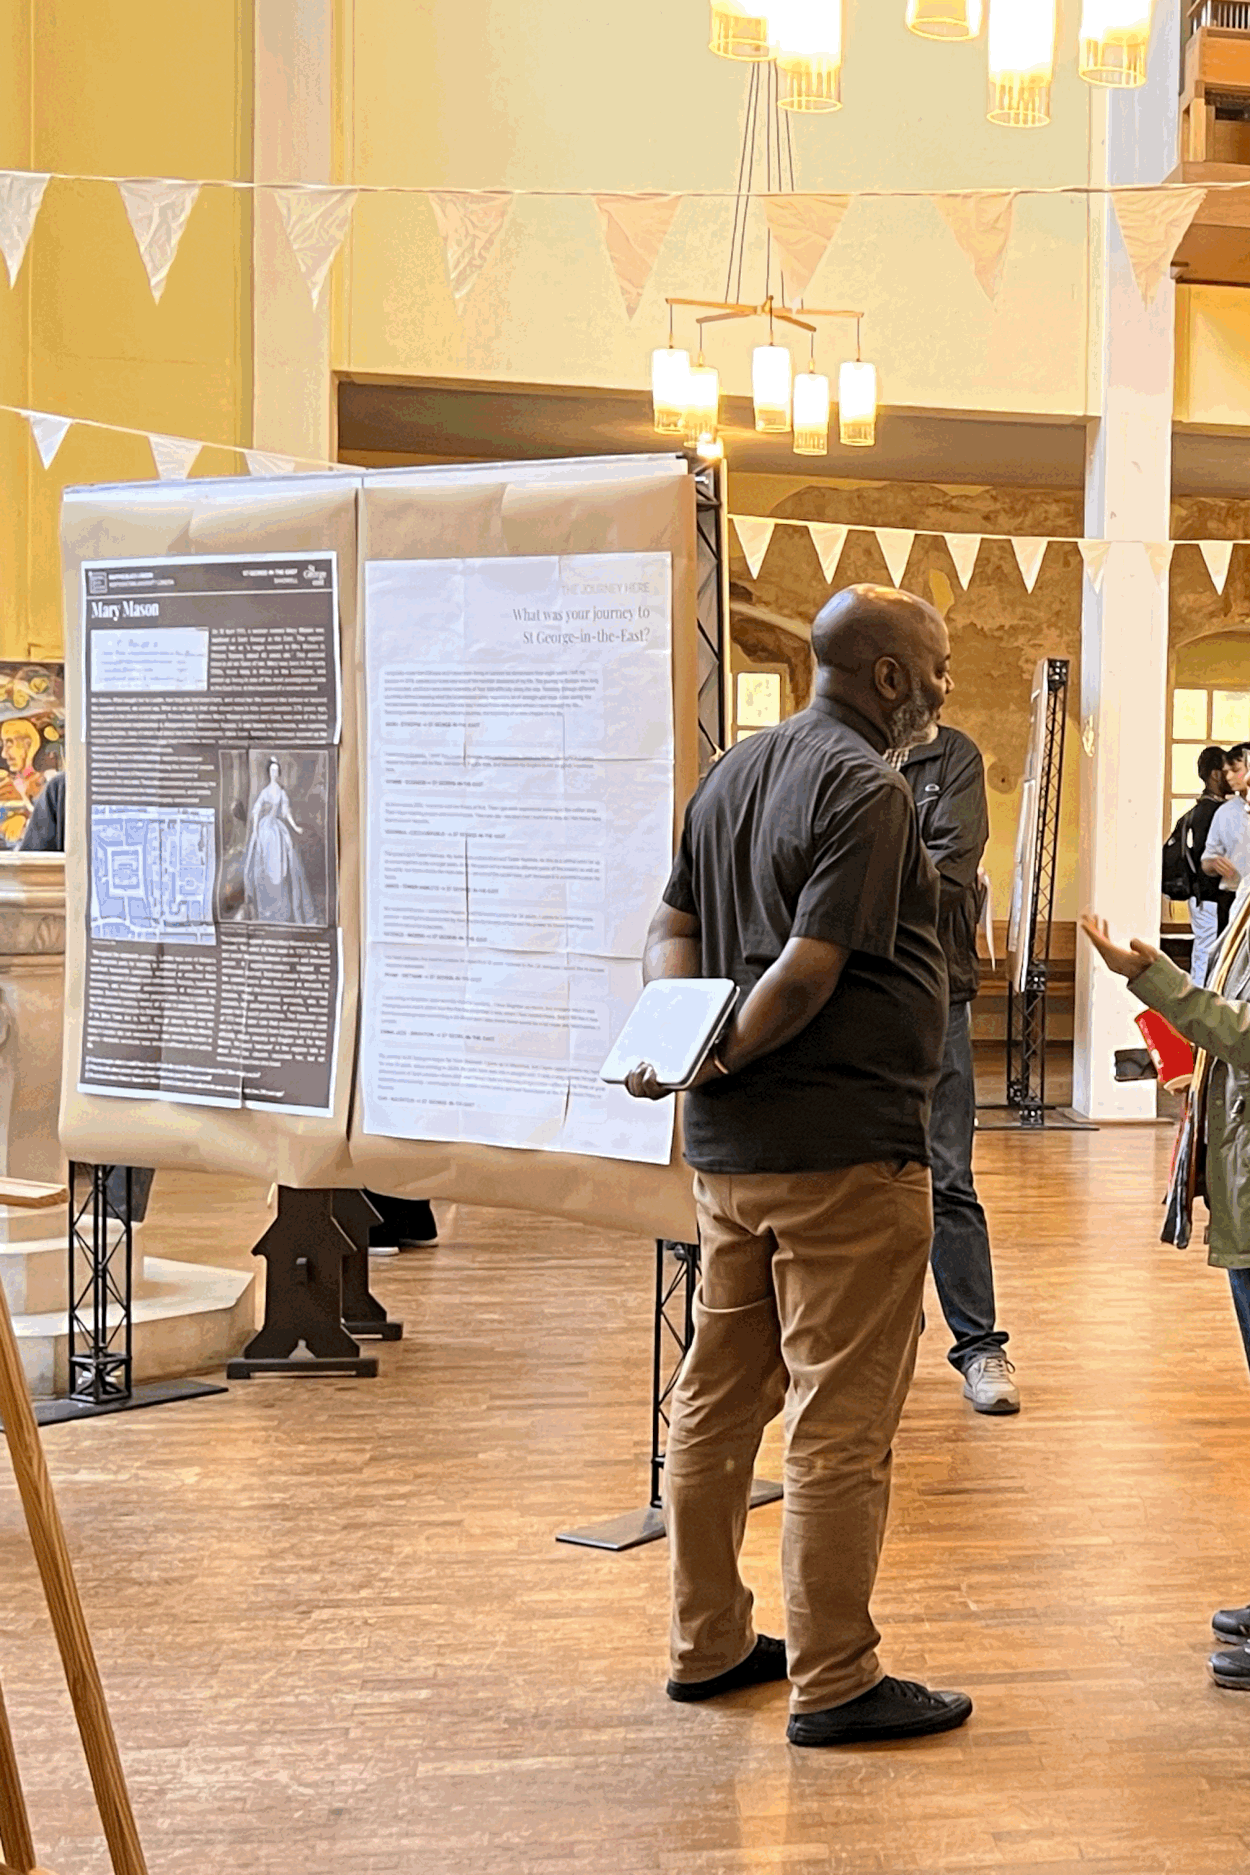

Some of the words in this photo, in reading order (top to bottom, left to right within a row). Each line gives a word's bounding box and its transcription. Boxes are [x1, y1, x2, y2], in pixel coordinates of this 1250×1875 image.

[91, 601, 120, 621] Mary
[122, 600, 159, 617] Mason
[512, 607, 540, 621] What
[543, 611, 563, 621] was
[566, 610, 590, 623] your
[593, 605, 633, 622] journey
[638, 605, 650, 619] to
[523, 631, 533, 644] St
[536, 628, 650, 644] George-in-the-East?
